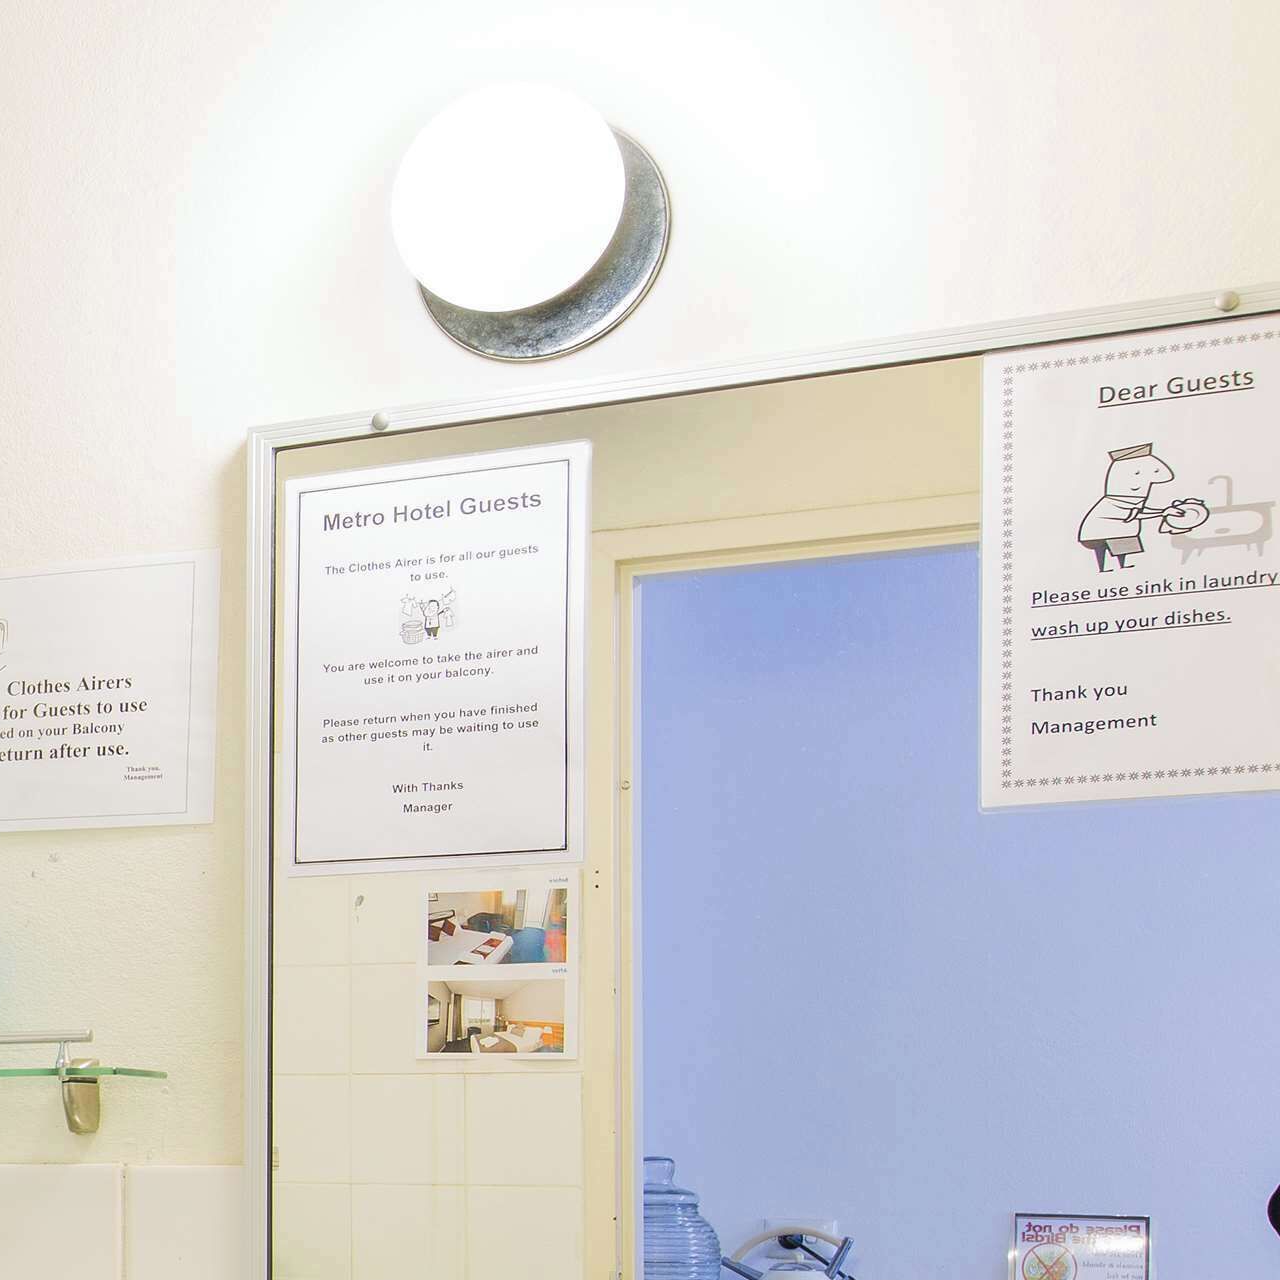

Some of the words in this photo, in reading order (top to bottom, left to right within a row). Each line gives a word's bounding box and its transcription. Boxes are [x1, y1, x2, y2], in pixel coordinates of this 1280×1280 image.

[1099, 383, 1158, 404] Dear
[1167, 369, 1254, 395] Guests
[323, 512, 384, 531] Metro
[394, 501, 450, 523] Hotel
[460, 492, 541, 514] Guests
[325, 565, 345, 575] The
[348, 560, 390, 573] Clothes
[395, 557, 421, 568] Airer
[426, 556, 435, 565] is
[439, 553, 455, 563] for
[459, 552, 472, 561] all
[476, 550, 495, 560] our
[499, 544, 539, 559] guests
[410, 573, 421, 581] to
[425, 571, 448, 580] use.
[1032, 587, 1091, 606] Please
[1097, 584, 1129, 599] use
[1135, 578, 1173, 596] sink
[1179, 575, 1197, 591] in
[1203, 569, 1277, 590] laundry
[1032, 620, 1078, 637] wash
[1086, 619, 1109, 636] up
[1115, 613, 1158, 632] your
[1164, 608, 1231, 626] dishes.
[323, 663, 344, 673] You
[348, 662, 365, 671] are
[369, 657, 418, 669] welcome
[422, 656, 433, 664] to
[437, 653, 460, 663] take
[465, 651, 482, 660] the
[486, 649, 512, 659] airer
[516, 646, 538, 656] and
[8, 679, 71, 696] Clothes
[77, 675, 132, 692] Airers
[364, 676, 383, 685] use
[388, 673, 394, 683] it
[398, 673, 412, 682] on
[416, 671, 441, 683] your
[445, 667, 494, 680] balcony.
[1031, 685, 1087, 702] Thank
[1094, 684, 1128, 699] you
[3, 706, 27, 721] for
[33, 700, 91, 719] Guests
[97, 701, 113, 715] to
[119, 699, 148, 713] use
[323, 718, 359, 728] Please
[363, 715, 396, 725] return
[400, 712, 430, 722] when
[434, 711, 455, 722] you
[459, 708, 486, 717] have
[490, 703, 538, 715] finished
[18, 727, 34, 738] on
[38, 724, 68, 739] your
[72, 722, 124, 735] Balcony
[322, 734, 334, 743] as
[338, 732, 367, 742] other
[371, 729, 408, 742] guests
[412, 728, 435, 737] may
[439, 725, 453, 734] be
[457, 722, 498, 733] waiting
[502, 720, 514, 730] to
[518, 720, 539, 728] use
[1031, 714, 1157, 736] Management
[49, 745, 91, 759] after
[96, 743, 128, 757] use.
[423, 742, 432, 751] it.
[123, 773, 163, 781] Management
[392, 783, 419, 794] With
[422, 781, 463, 792] Thanks
[403, 802, 453, 815] Manager
